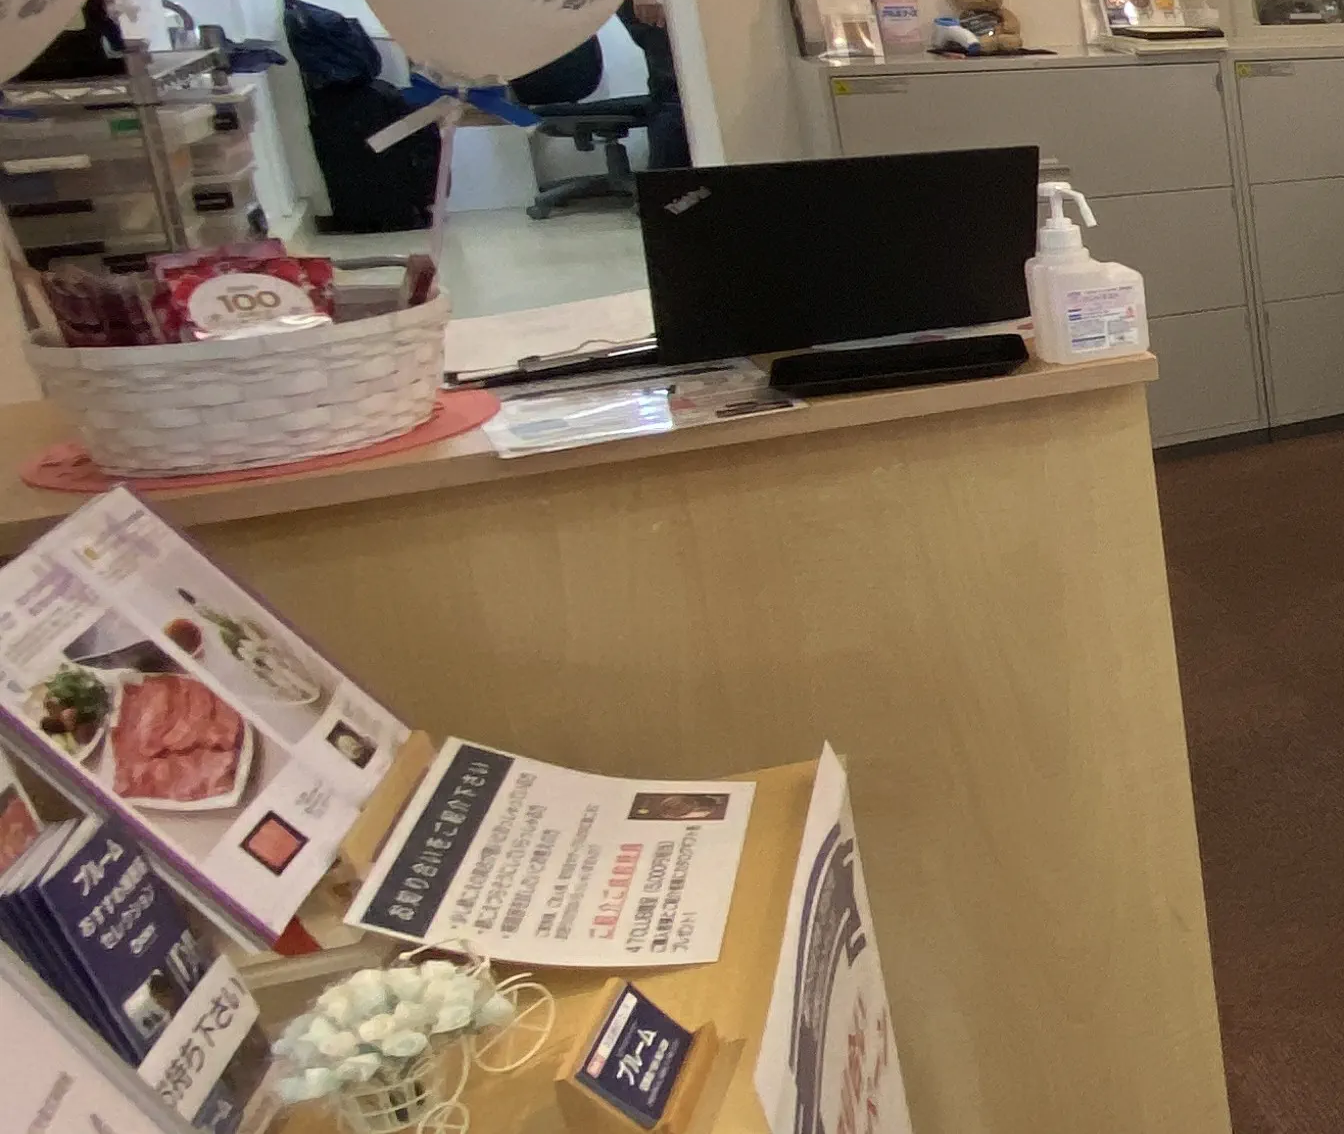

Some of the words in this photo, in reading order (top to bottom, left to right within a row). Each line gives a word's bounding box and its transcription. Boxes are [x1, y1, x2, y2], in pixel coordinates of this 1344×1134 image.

[216, 291, 280, 312] 100
[617, 1027, 657, 1087] ブルーム
